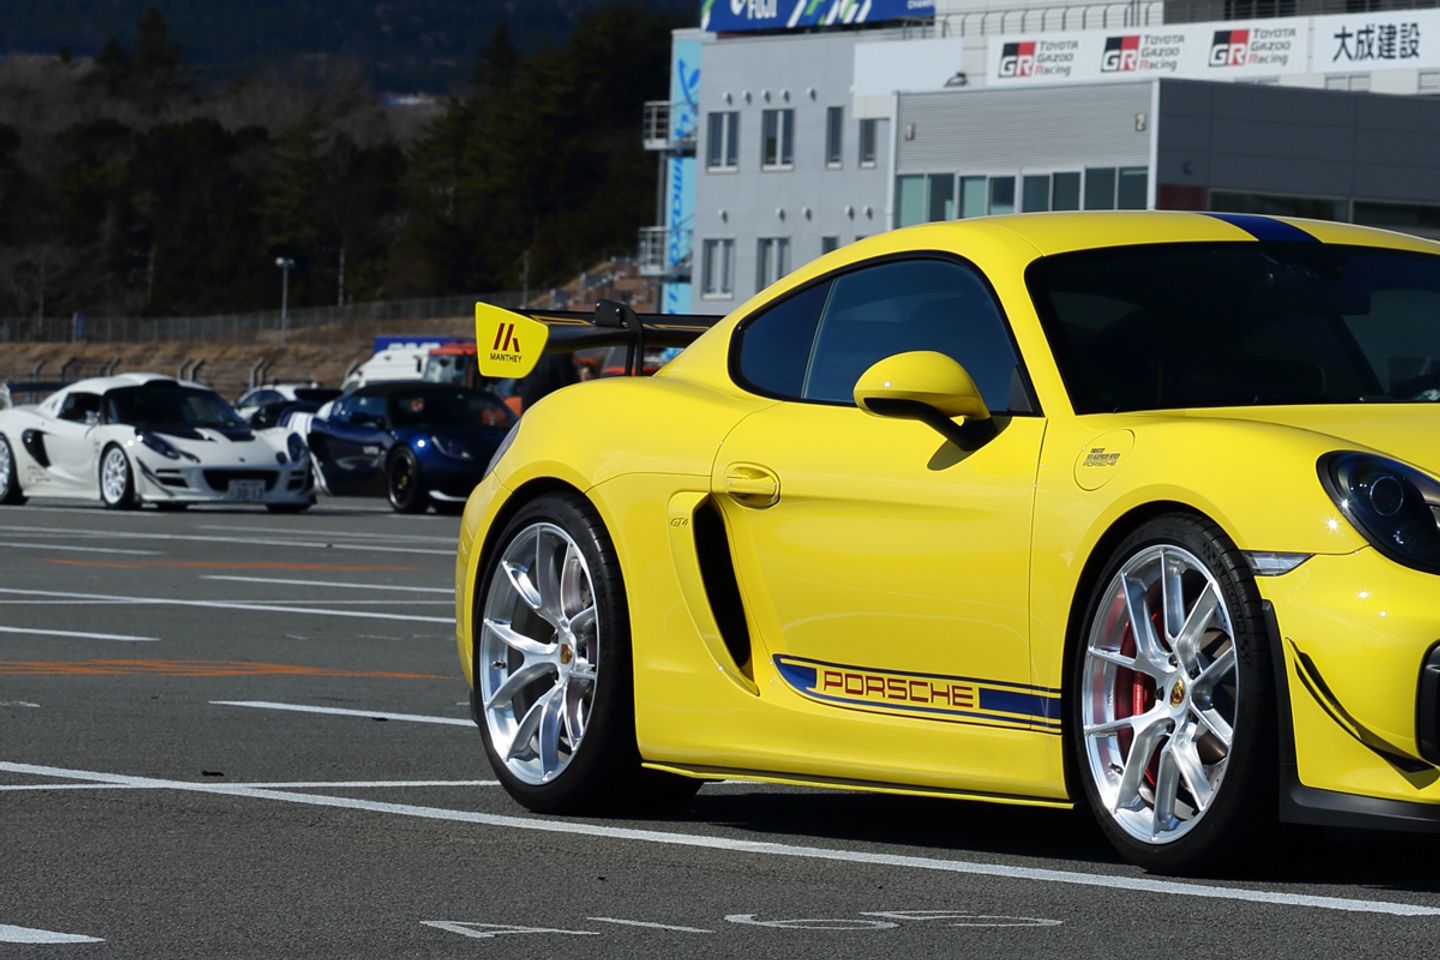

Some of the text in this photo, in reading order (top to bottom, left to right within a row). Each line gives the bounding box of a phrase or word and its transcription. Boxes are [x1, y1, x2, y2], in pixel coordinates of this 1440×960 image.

[1144, 34, 1185, 45] TOYOTA
[1253, 28, 1296, 39] TOYOTA
[1040, 40, 1079, 51] TOYOTA
[1250, 41, 1291, 51] GAZOO
[1332, 23, 1420, 63] 大成建設
[1037, 52, 1073, 63] GAZOO
[1141, 47, 1180, 57] GAZOO
[1210, 43, 1247, 66] GR
[999, 55, 1034, 77] GR
[1102, 49, 1137, 71] GR
[1139, 59, 1177, 72] Racing
[1248, 53, 1288, 66] Racing
[1035, 64, 1071, 77] Racing
[490, 352, 522, 363] MANTHEY
[824, 670, 974, 708] PORSCHE
